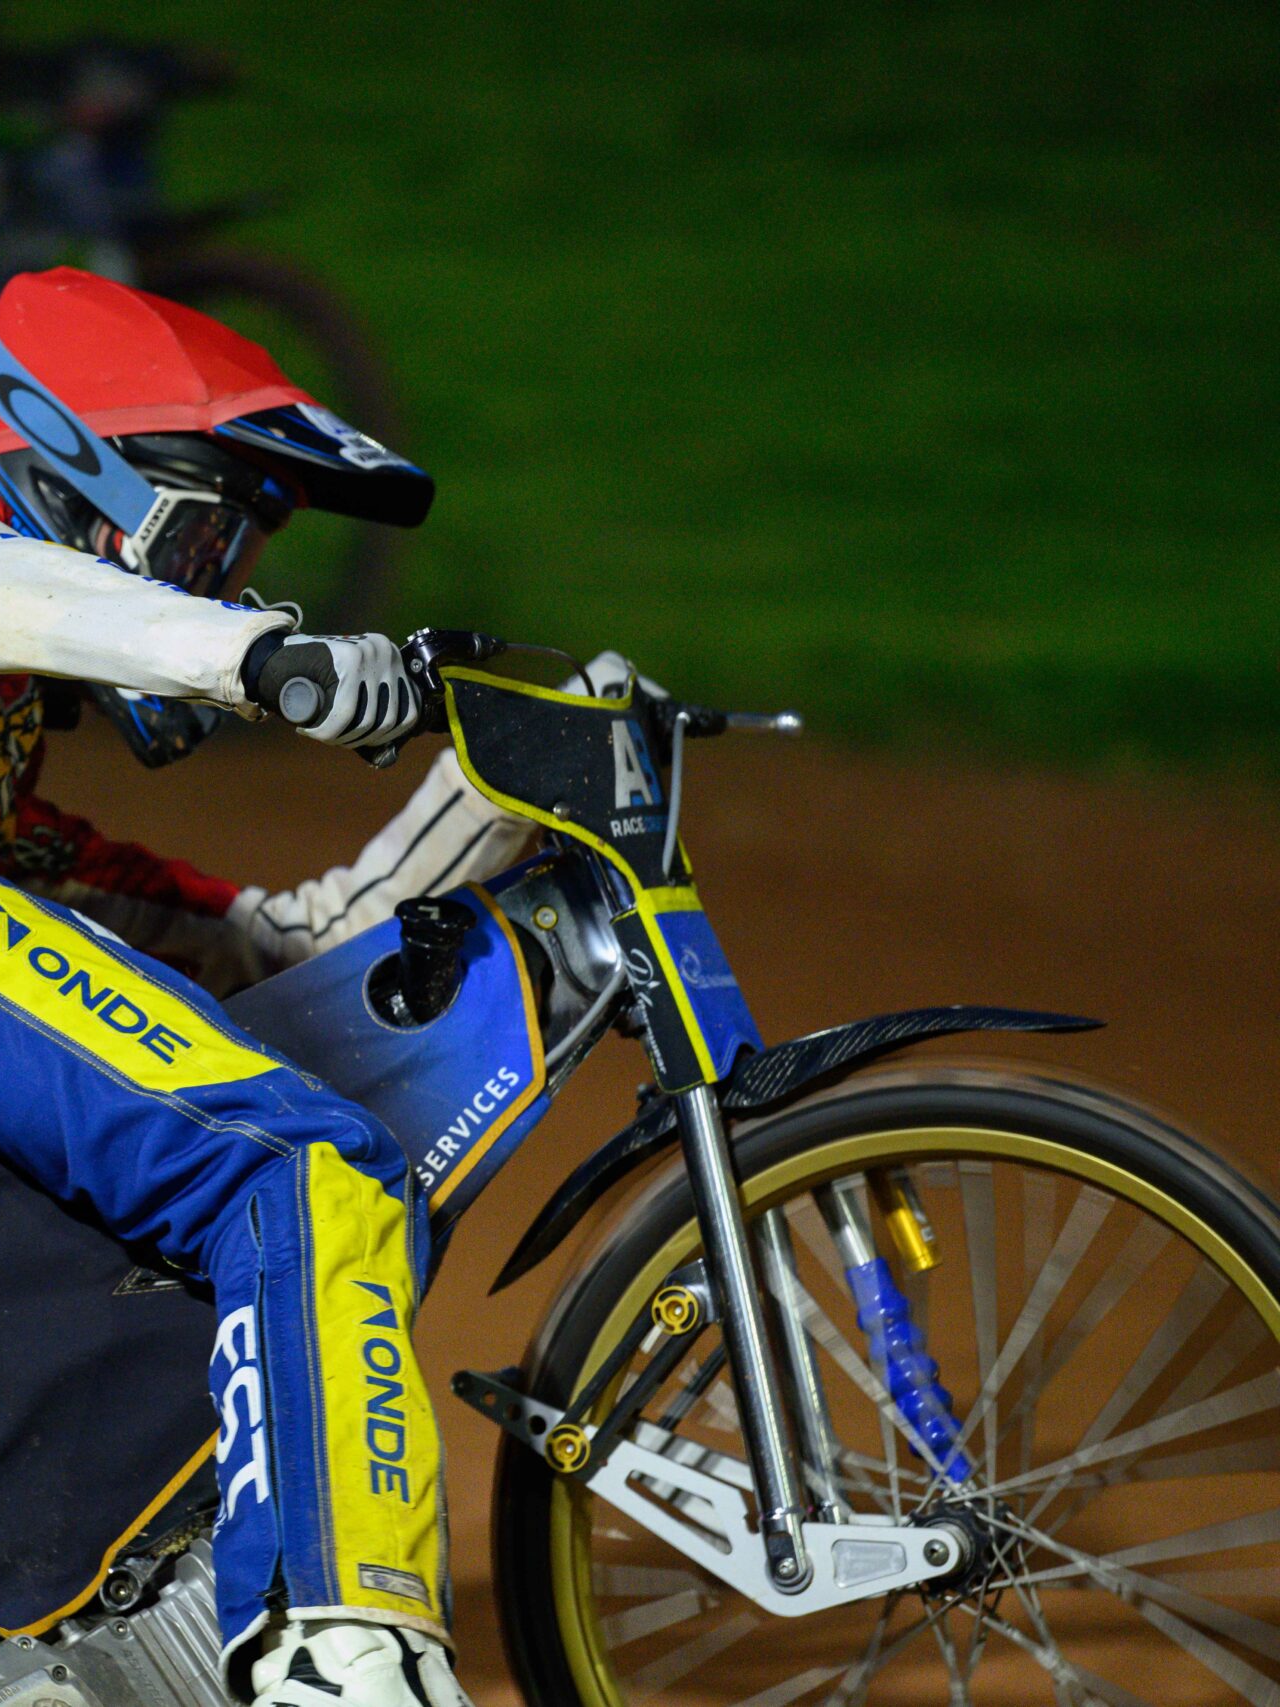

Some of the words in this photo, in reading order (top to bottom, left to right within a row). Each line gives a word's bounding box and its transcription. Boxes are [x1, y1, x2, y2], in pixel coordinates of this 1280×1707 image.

[140, 498, 169, 542] OAKLEY
[30, 947, 192, 1066] ONDE
[416, 1066, 520, 1190] SERVICES
[363, 1338, 410, 1504] ONDE
